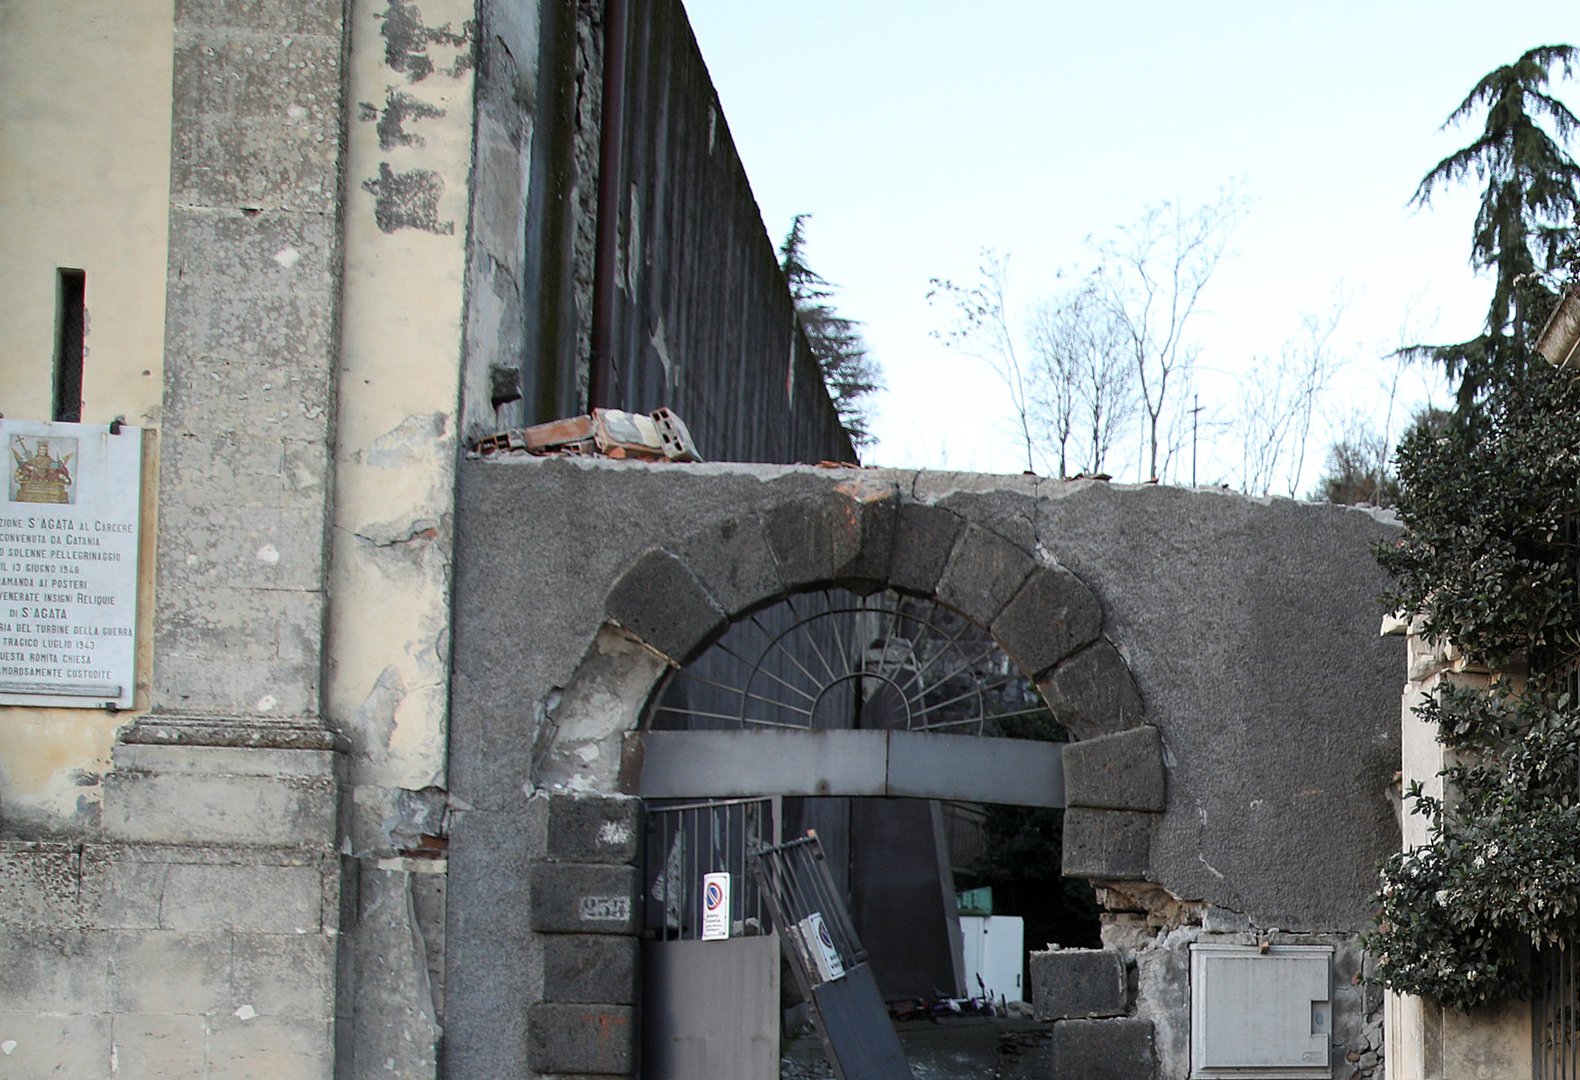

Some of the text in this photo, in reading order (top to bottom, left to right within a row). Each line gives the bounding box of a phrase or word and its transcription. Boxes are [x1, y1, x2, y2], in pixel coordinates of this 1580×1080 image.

[79, 522, 89, 532] AL
[94, 521, 134, 534] CARCERE
[50, 536, 62, 545] DA
[66, 535, 101, 546] CATANIA
[8, 548, 46, 559] SOLENNE
[50, 551, 121, 562] PELLEGRINAGGIO
[12, 563, 21, 572] 13
[26, 564, 56, 573] GIUGNO
[60, 565, 80, 575] 1948
[0, 578, 87, 589] AMANDA AI POSTERI
[44, 594, 73, 603] INSIGNI
[77, 593, 116, 606] RELIQUIE
[9, 609, 18, 618] DI
[16, 624, 32, 633] DEL
[37, 625, 70, 634] TURBINE
[74, 626, 99, 636] DELLA
[103, 627, 133, 637] GUERRA
[3, 637, 95, 649] TRAGICO LUGLIO 1943
[30, 653, 58, 663] ROMITA
[63, 654, 92, 664] CHIESA
[0, 666, 111, 680] MOROSAMENTE CUSTODITE
